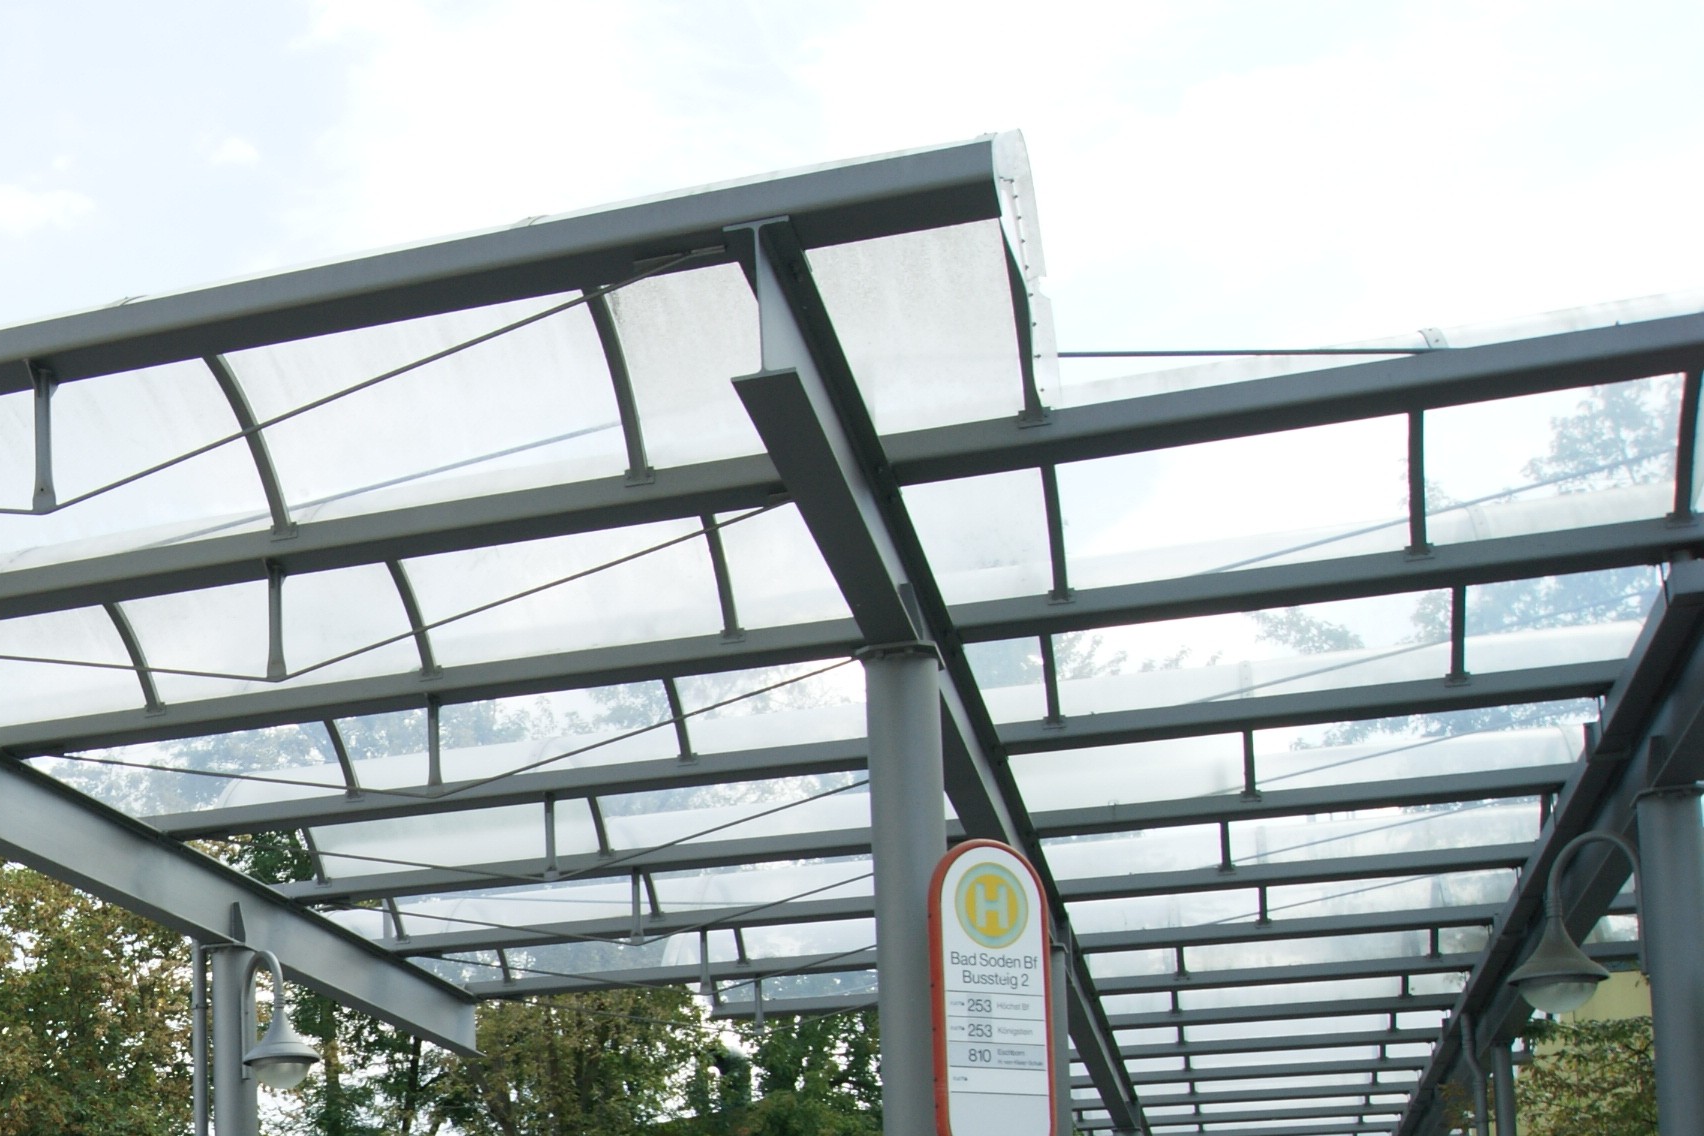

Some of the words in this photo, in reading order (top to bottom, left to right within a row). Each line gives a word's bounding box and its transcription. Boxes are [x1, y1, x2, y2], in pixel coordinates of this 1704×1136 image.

[975, 882, 1009, 929] H
[950, 951, 977, 966] Bad
[979, 953, 1021, 969] Soden
[1023, 955, 1038, 969] Bf
[962, 970, 1018, 990] Bussteig
[1021, 973, 1030, 987] 2
[967, 998, 992, 1013] 253
[967, 1023, 993, 1038] 253
[968, 1048, 992, 1063] 810
